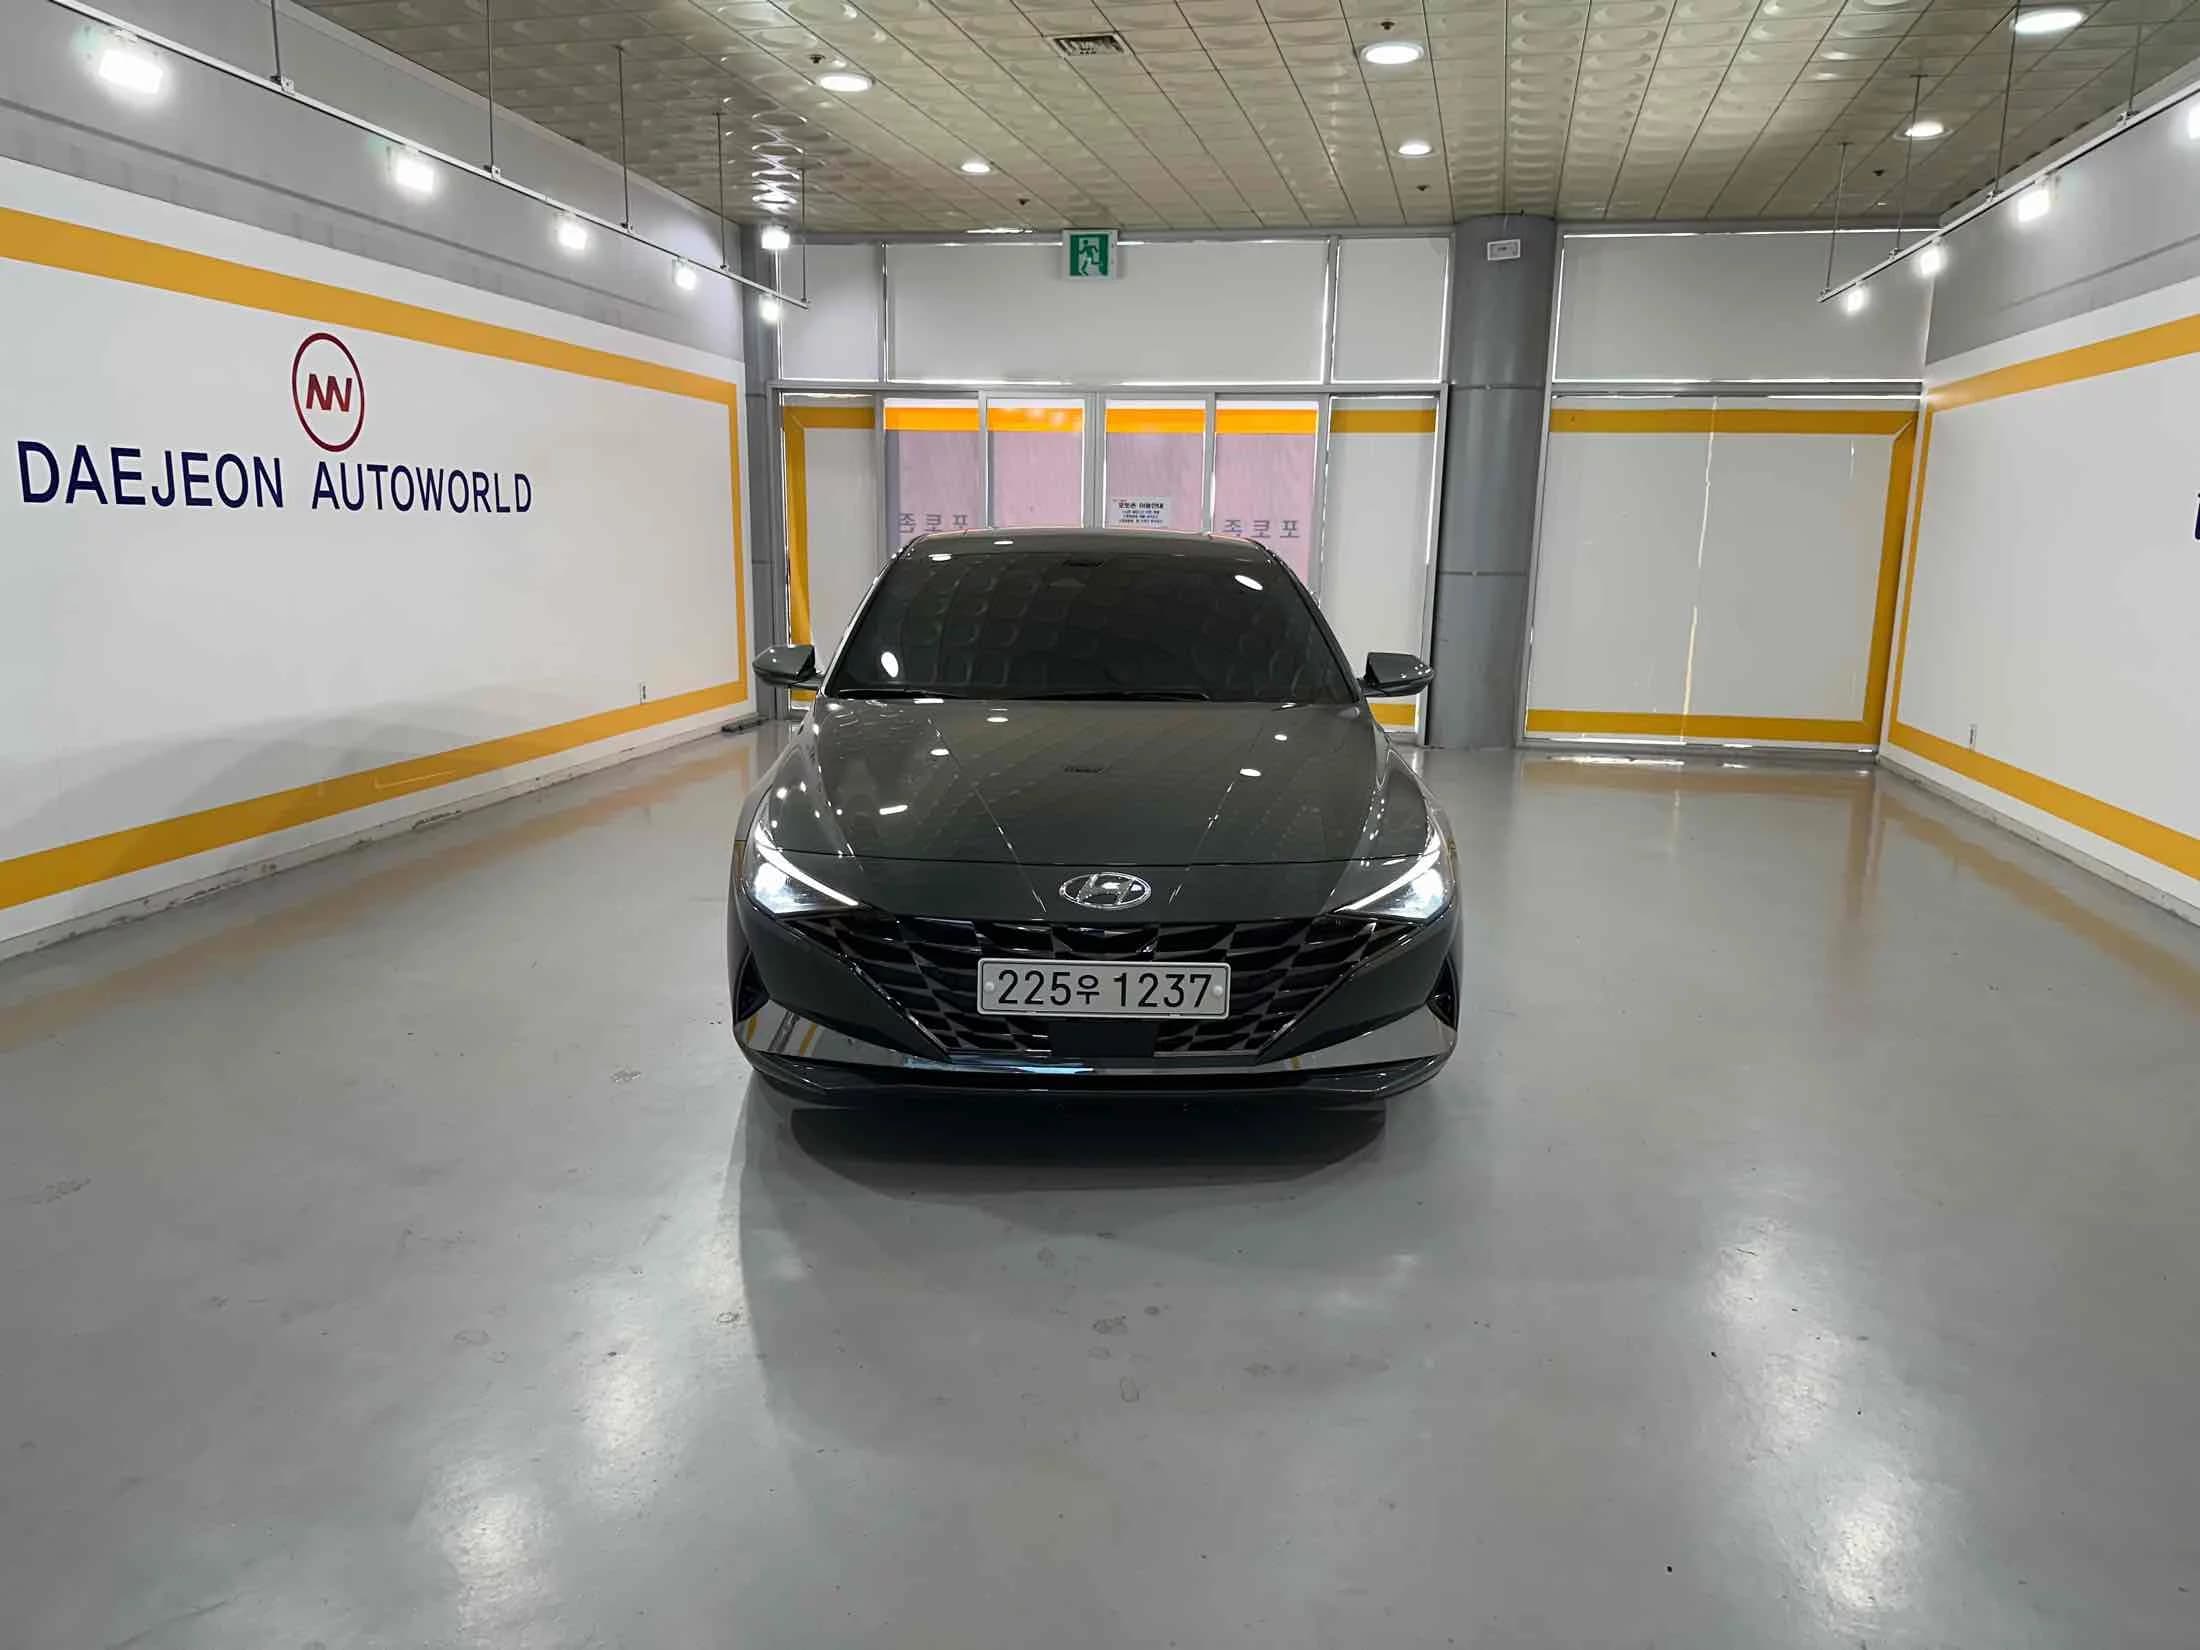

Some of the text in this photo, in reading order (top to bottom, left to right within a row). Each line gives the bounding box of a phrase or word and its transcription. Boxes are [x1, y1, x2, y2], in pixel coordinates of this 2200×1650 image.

[17, 440, 532, 513] DAEJEON AUTOWORLD
[998, 969, 1212, 1008] 225우 1237
